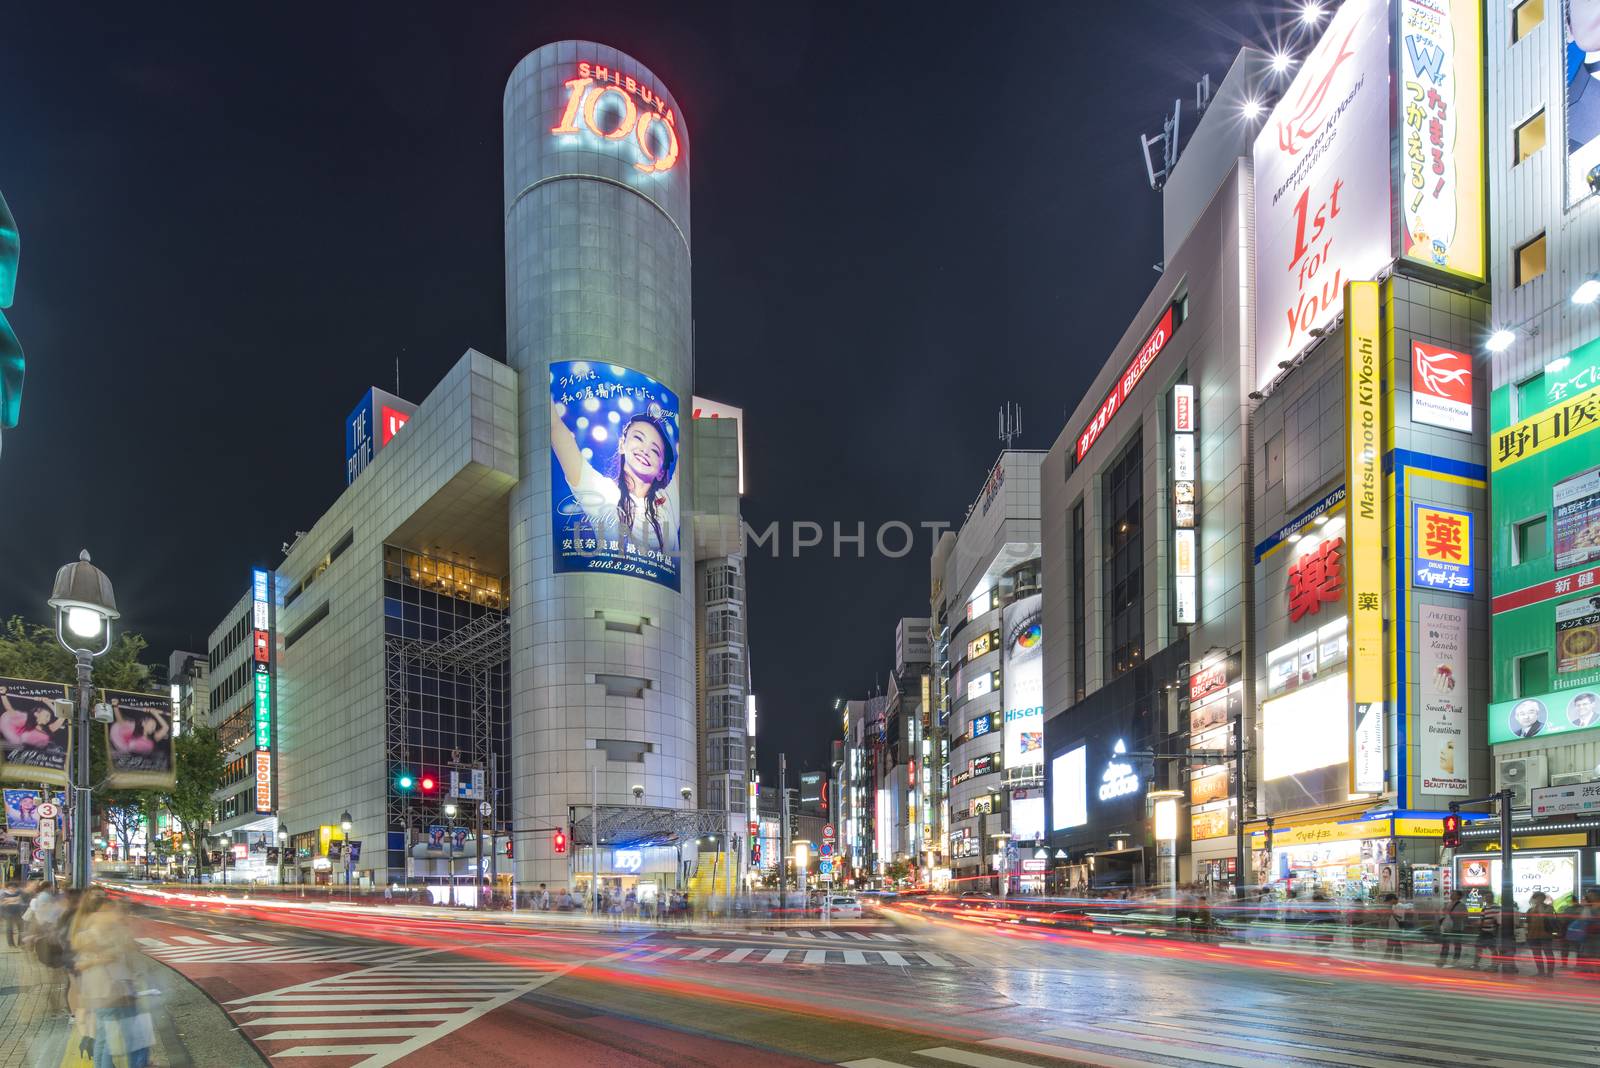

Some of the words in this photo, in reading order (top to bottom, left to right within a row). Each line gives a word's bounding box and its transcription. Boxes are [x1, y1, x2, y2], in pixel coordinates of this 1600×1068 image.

[578, 62, 675, 126] SHIBUYA
[551, 78, 679, 173] 109
[1272, 131, 1326, 207] Matsumoto
[1288, 176, 1345, 272] 1st
[1298, 236, 1334, 291] for
[1124, 363, 1140, 398] BIG
[1139, 330, 1165, 371] ECHO
[1358, 336, 1374, 407] KiYoshi
[353, 408, 366, 451] THE
[1080, 392, 1118, 456] カラオケ
[1498, 392, 1600, 463] 野口医
[1360, 409, 1375, 520] Matsumoto
[1279, 504, 1325, 541] Matsumoto
[1425, 513, 1462, 561] 薬
[588, 560, 635, 572] 2018.8.29
[1286, 536, 1346, 624] 薬
[1358, 592, 1379, 611] 薬
[43, 804, 53, 816] 3
[257, 756, 269, 807] HOOTERS
[1423, 779, 1448, 789] BEAUTY
[1448, 782, 1468, 791] SALON
[1514, 884, 1560, 894] ルメタウン
